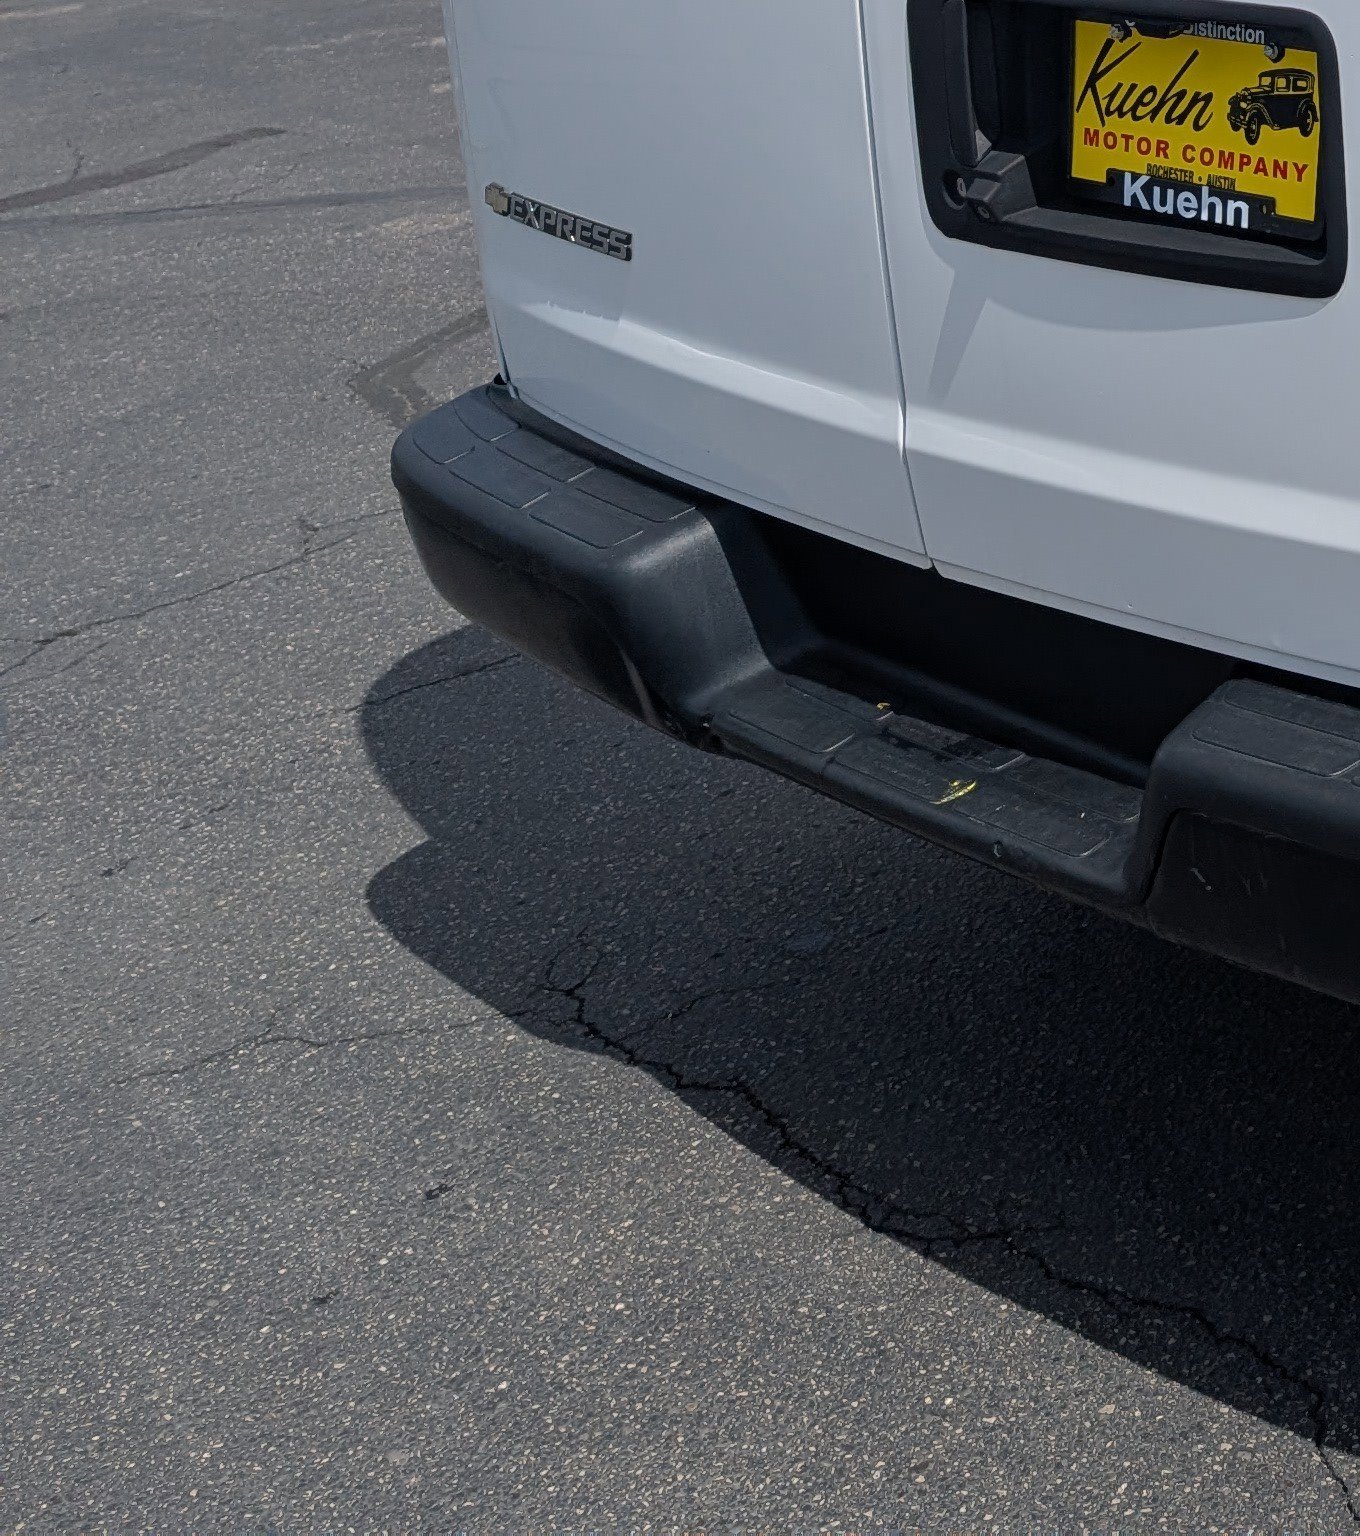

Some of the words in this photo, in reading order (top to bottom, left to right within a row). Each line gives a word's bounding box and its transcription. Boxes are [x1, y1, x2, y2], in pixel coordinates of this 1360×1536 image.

[1076, 38, 1214, 132] Kuehn
[1083, 127, 1170, 160] MOTOR
[1181, 144, 1309, 183] COMPANY
[1146, 163, 1195, 183] ROCHESTER
[509, 193, 632, 261] EXPRESS
[1123, 172, 1250, 229] Kuehn
